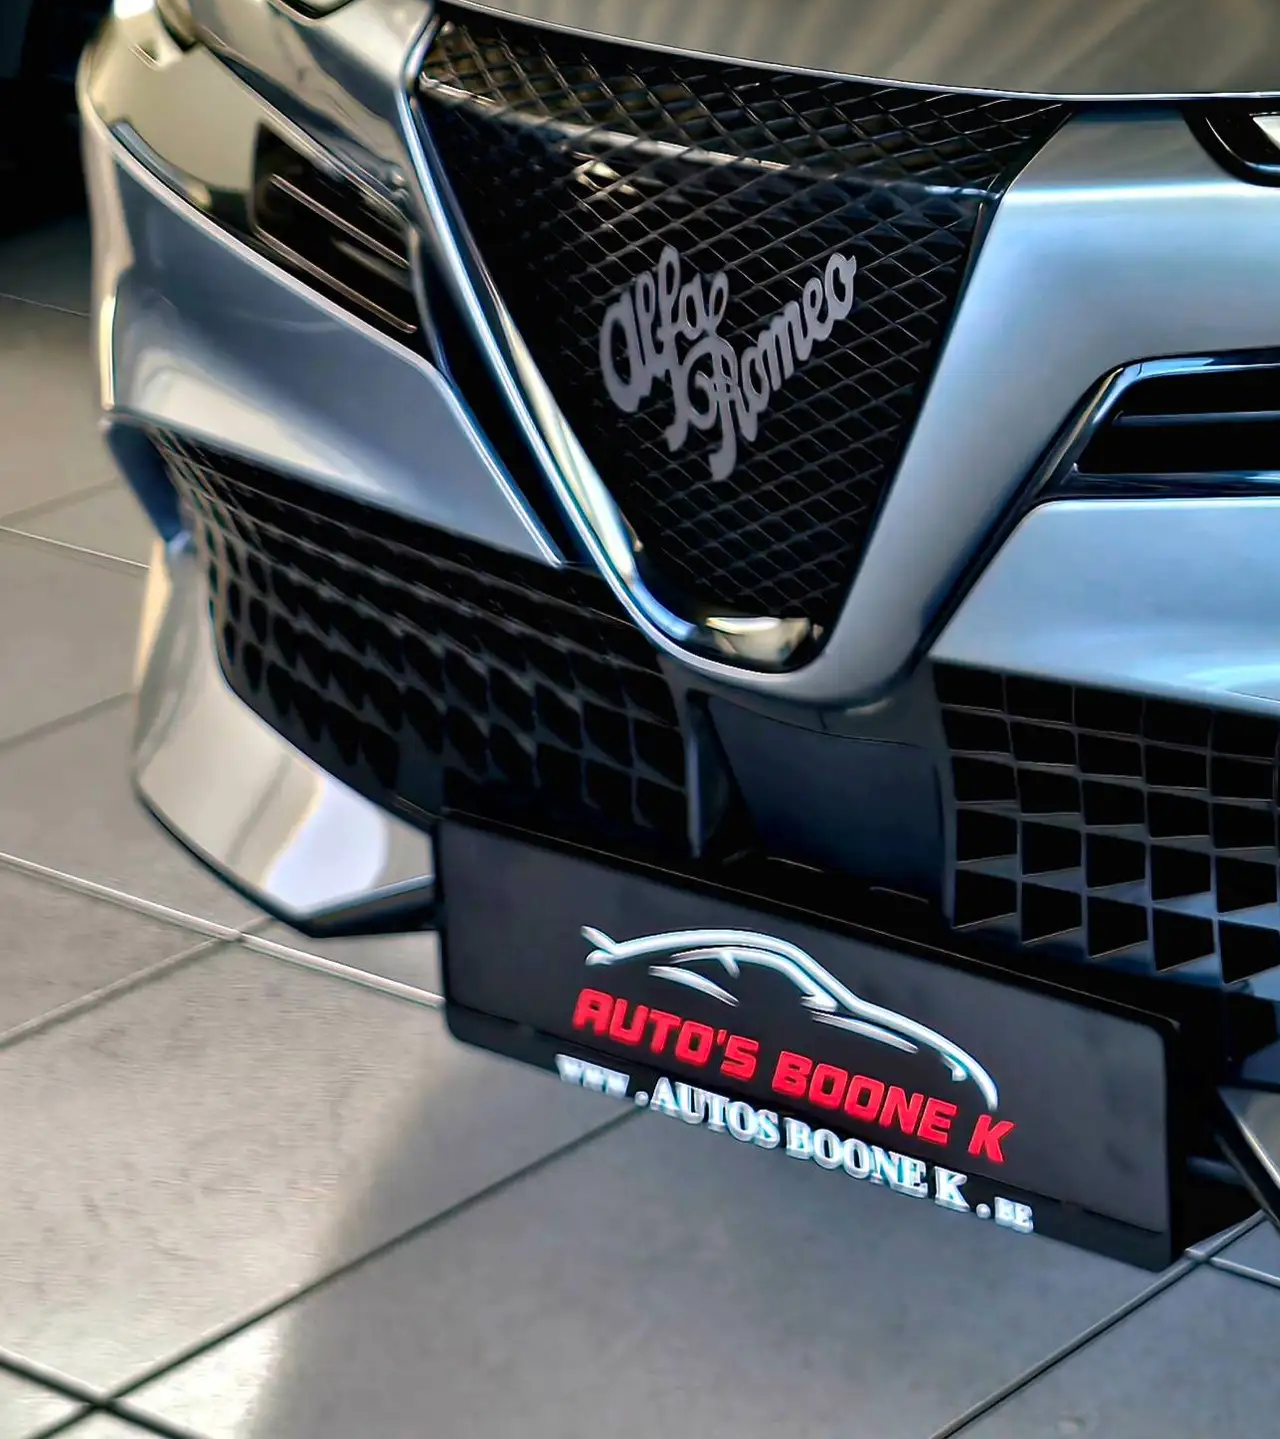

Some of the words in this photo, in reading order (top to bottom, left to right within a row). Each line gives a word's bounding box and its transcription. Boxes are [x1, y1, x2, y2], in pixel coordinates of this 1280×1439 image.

[600, 245, 729, 452] Alfa
[683, 253, 857, 482] Romeo
[572, 987, 760, 1081] AUTO'S
[771, 1050, 958, 1146] BOONE
[968, 1113, 1017, 1164] K
